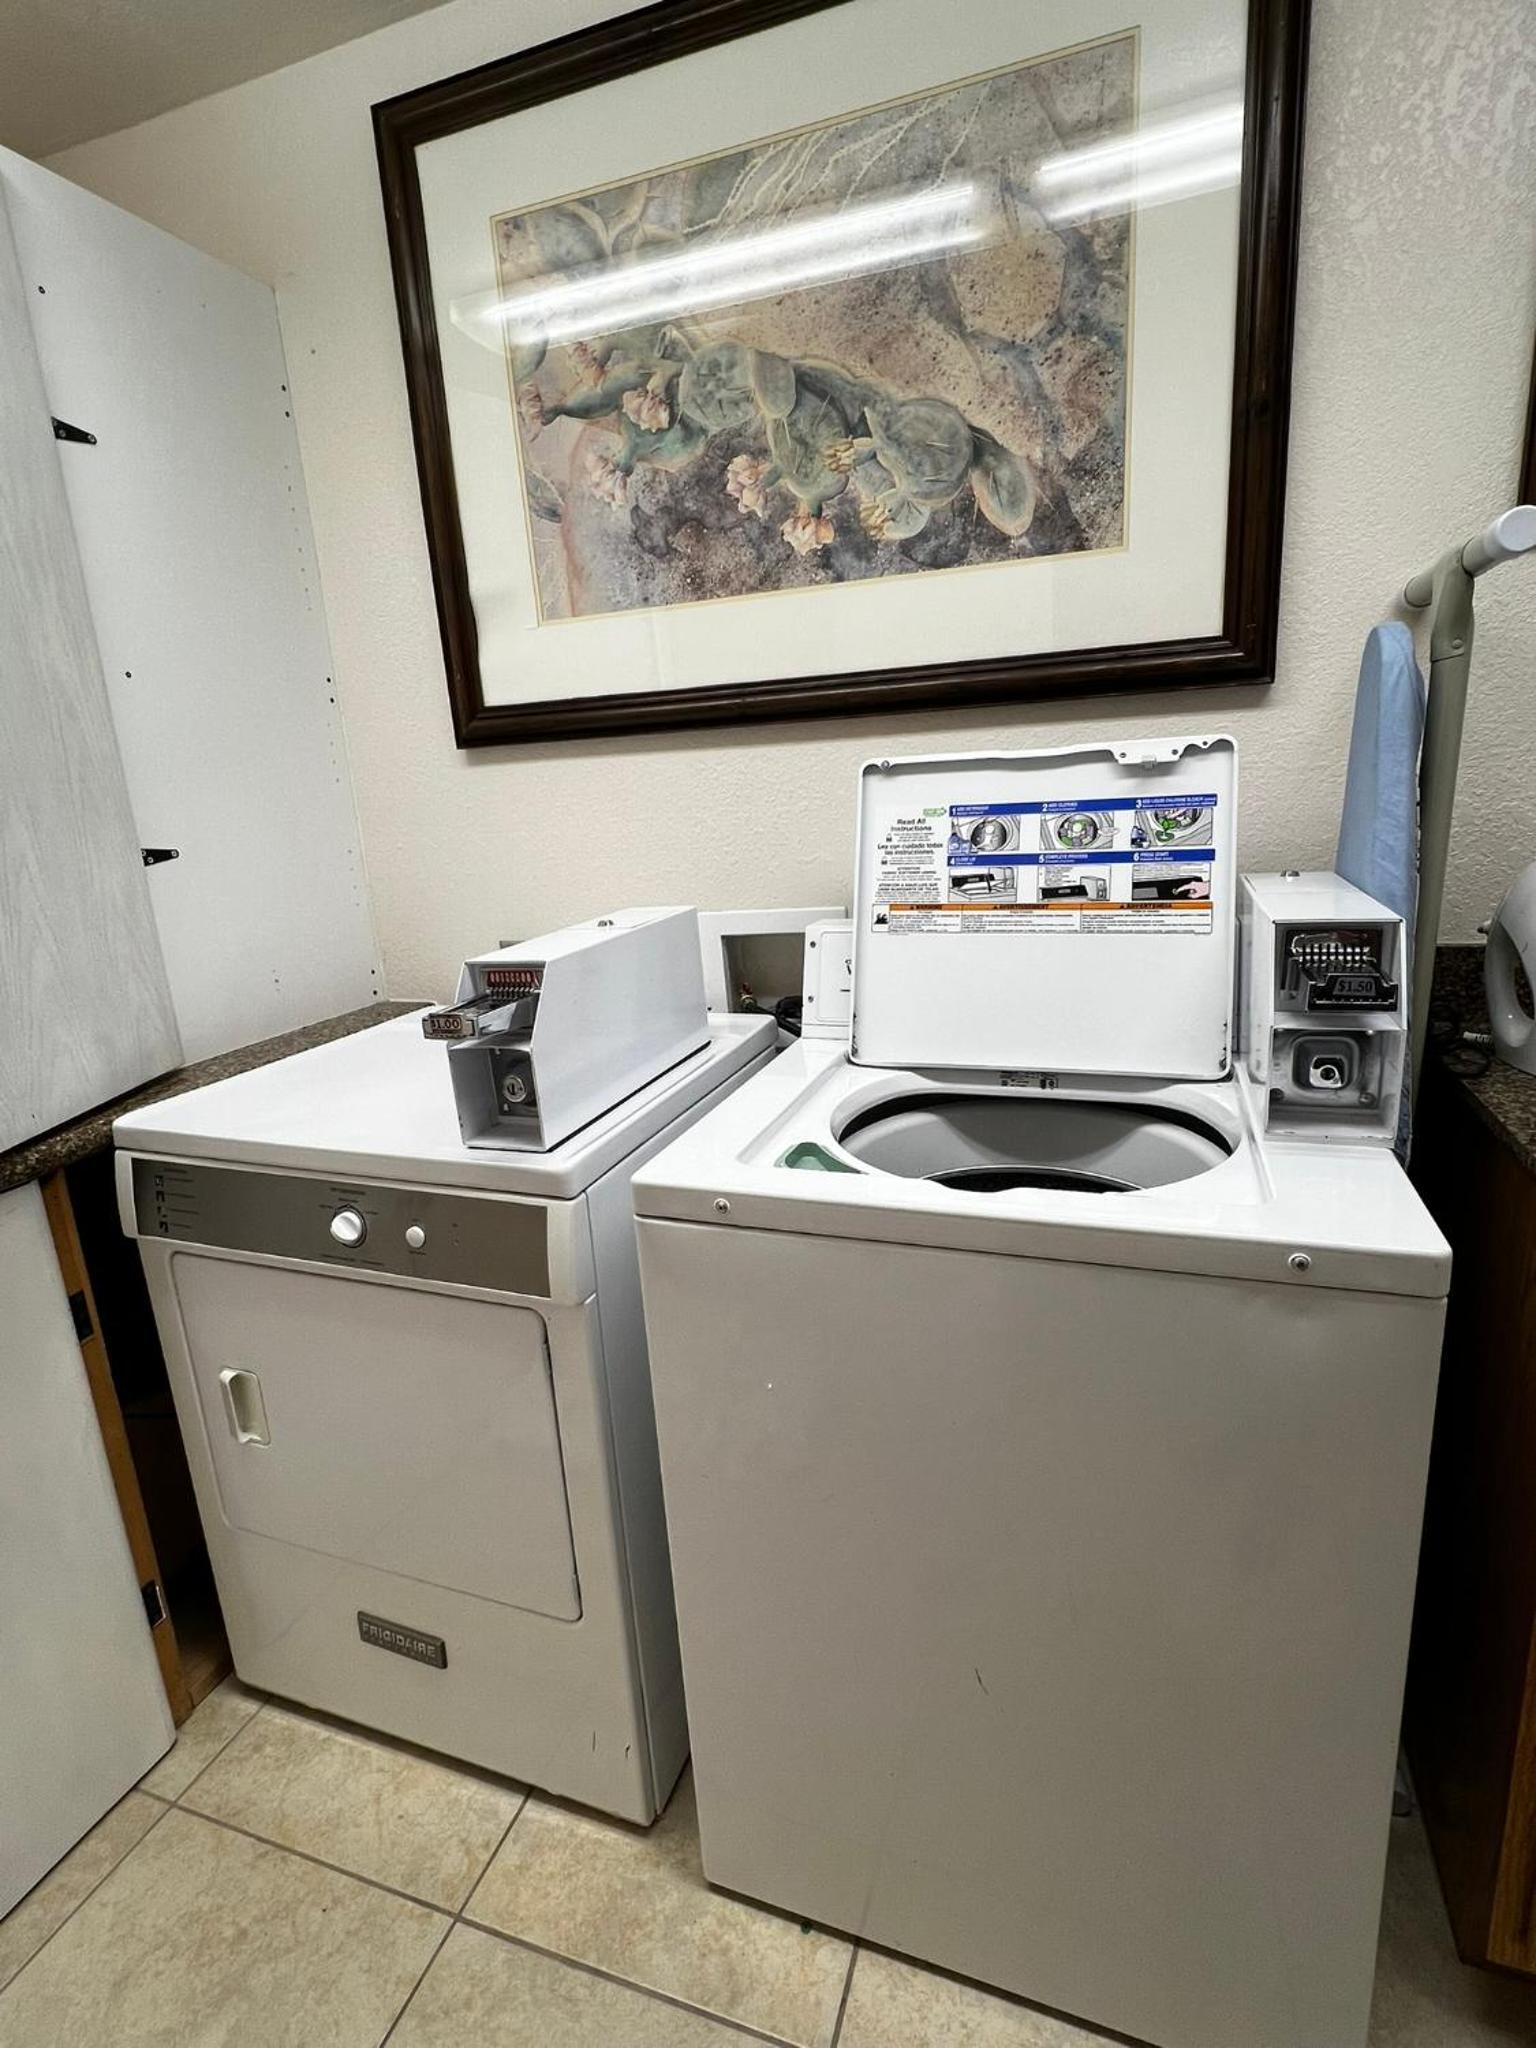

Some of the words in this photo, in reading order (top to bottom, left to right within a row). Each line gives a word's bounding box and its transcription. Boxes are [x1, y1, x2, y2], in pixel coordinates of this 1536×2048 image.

[1042, 803, 1048, 812] 2
[1135, 799, 1142, 809] 3
[950, 857, 955, 865] 4
[1039, 854, 1045, 864] 5
[1133, 852, 1140, 861] 6
[1337, 981, 1373, 994] $1.50
[431, 1018, 460, 1030] $1.00
[362, 1620, 436, 1658] FRIGIDAIRE
